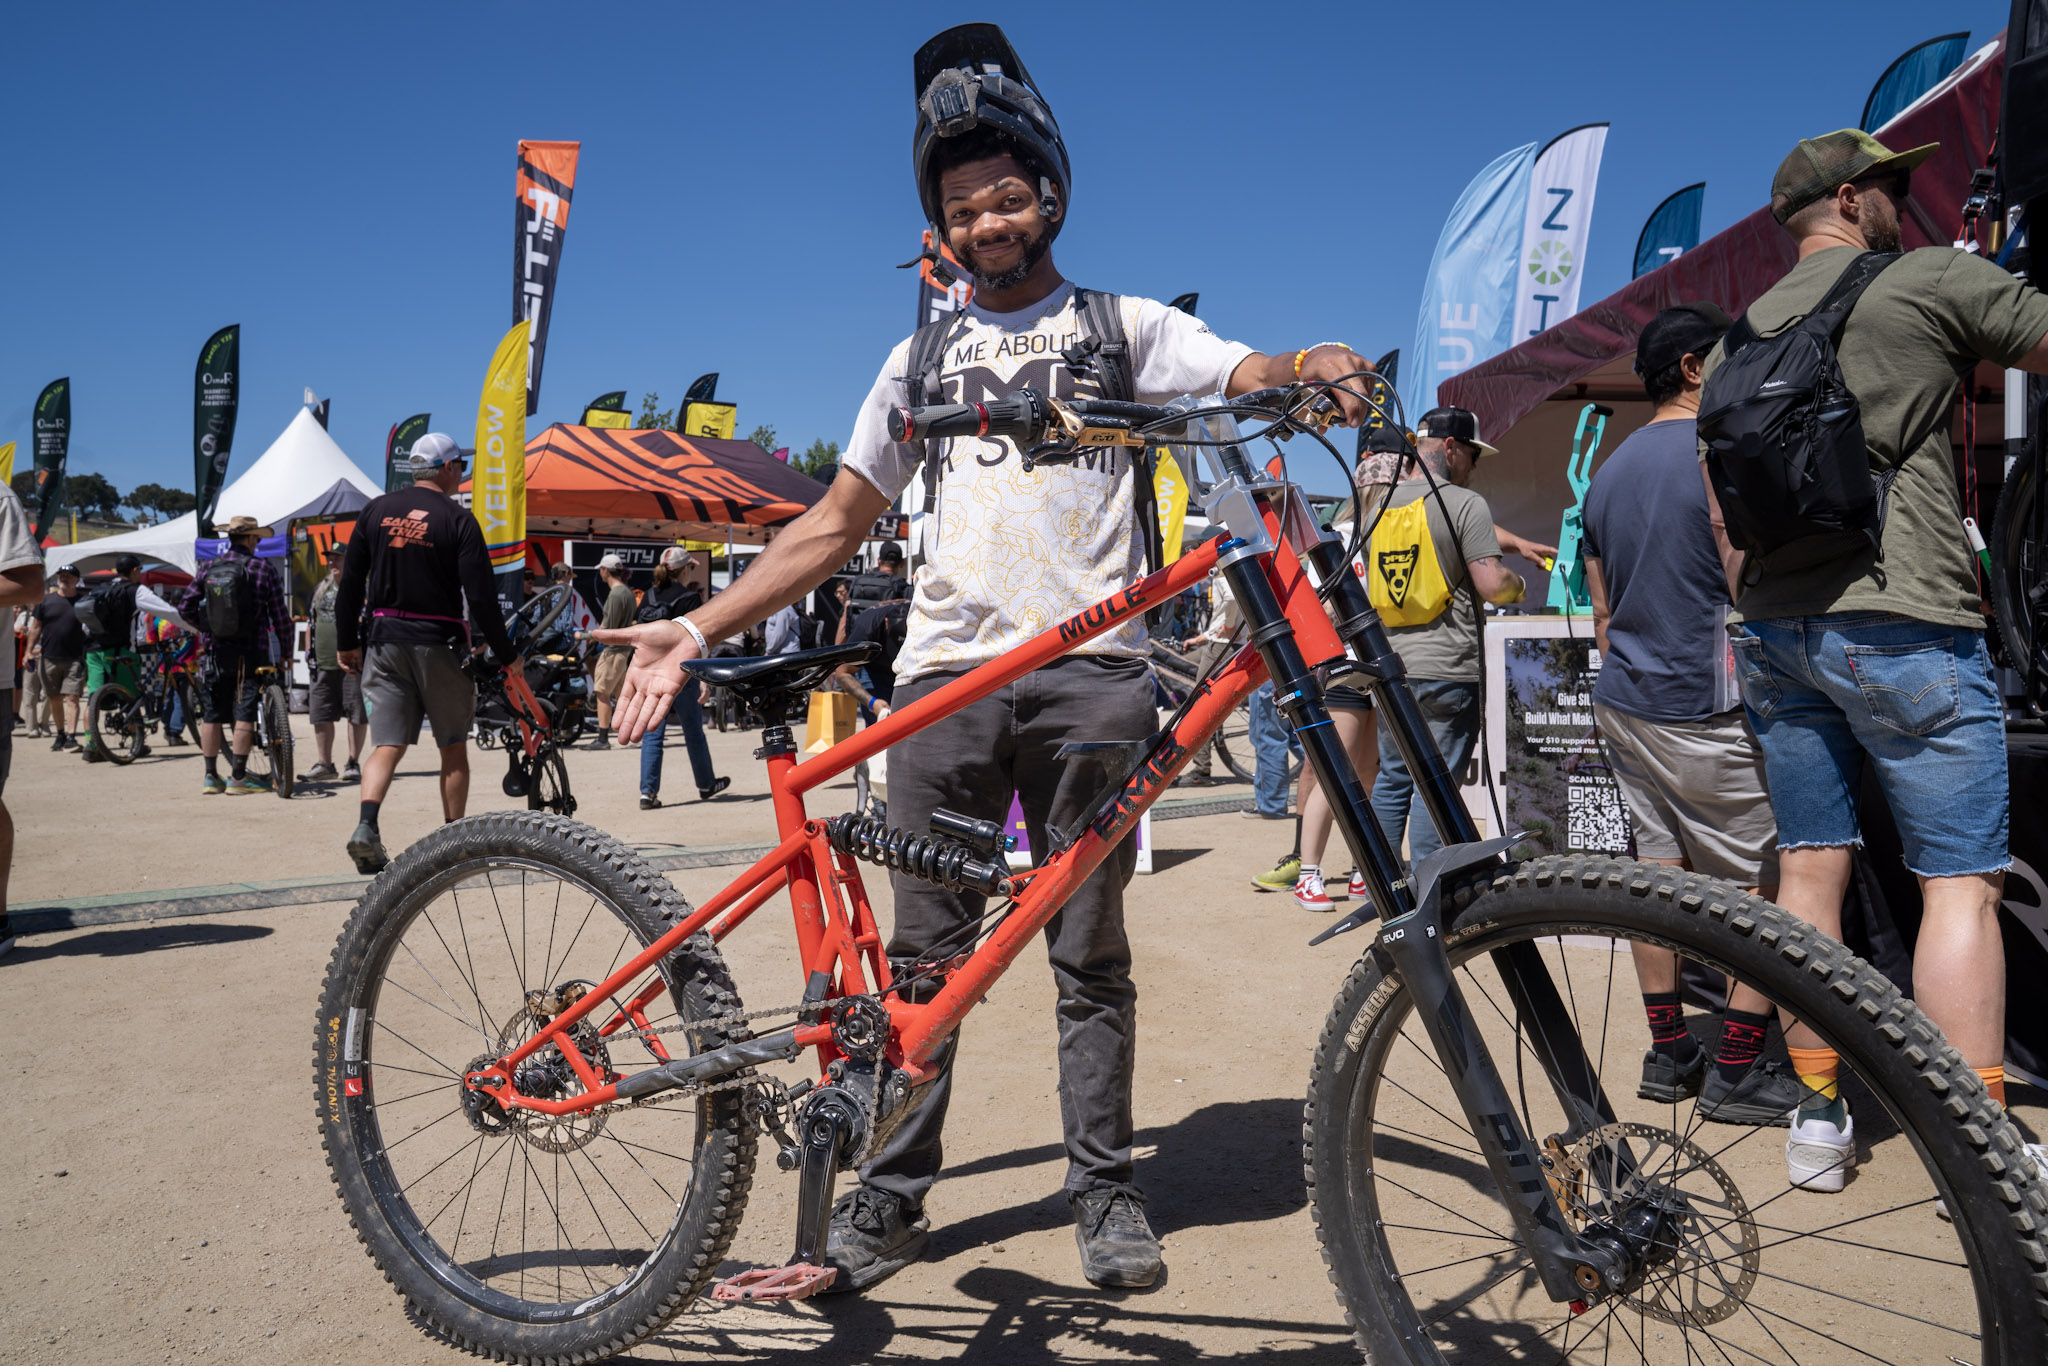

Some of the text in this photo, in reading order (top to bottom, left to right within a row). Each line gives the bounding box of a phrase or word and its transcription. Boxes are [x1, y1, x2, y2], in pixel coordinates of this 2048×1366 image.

[954, 332, 1078, 367] ME ABOUT
[485, 404, 507, 533] YELLOW
[380, 517, 429, 531] SANTA
[388, 526, 428, 540] CRUZ
[1058, 583, 1147, 644] MULE
[1557, 692, 1577, 706] Give
[1525, 711, 1596, 726] Build What Mak
[1526, 736, 1544, 744] Your
[1545, 736, 1560, 744] $10
[1561, 738, 1596, 746] supports
[1539, 746, 1566, 754] access,
[1569, 776, 1593, 784] SCAN
[1594, 776, 1607, 785] TO
[1391, 878, 1408, 892] RU
[1382, 928, 1405, 944] EVO
[1343, 974, 1402, 1053] ASSEGAI
[1796, 1149, 1841, 1166] adidas
